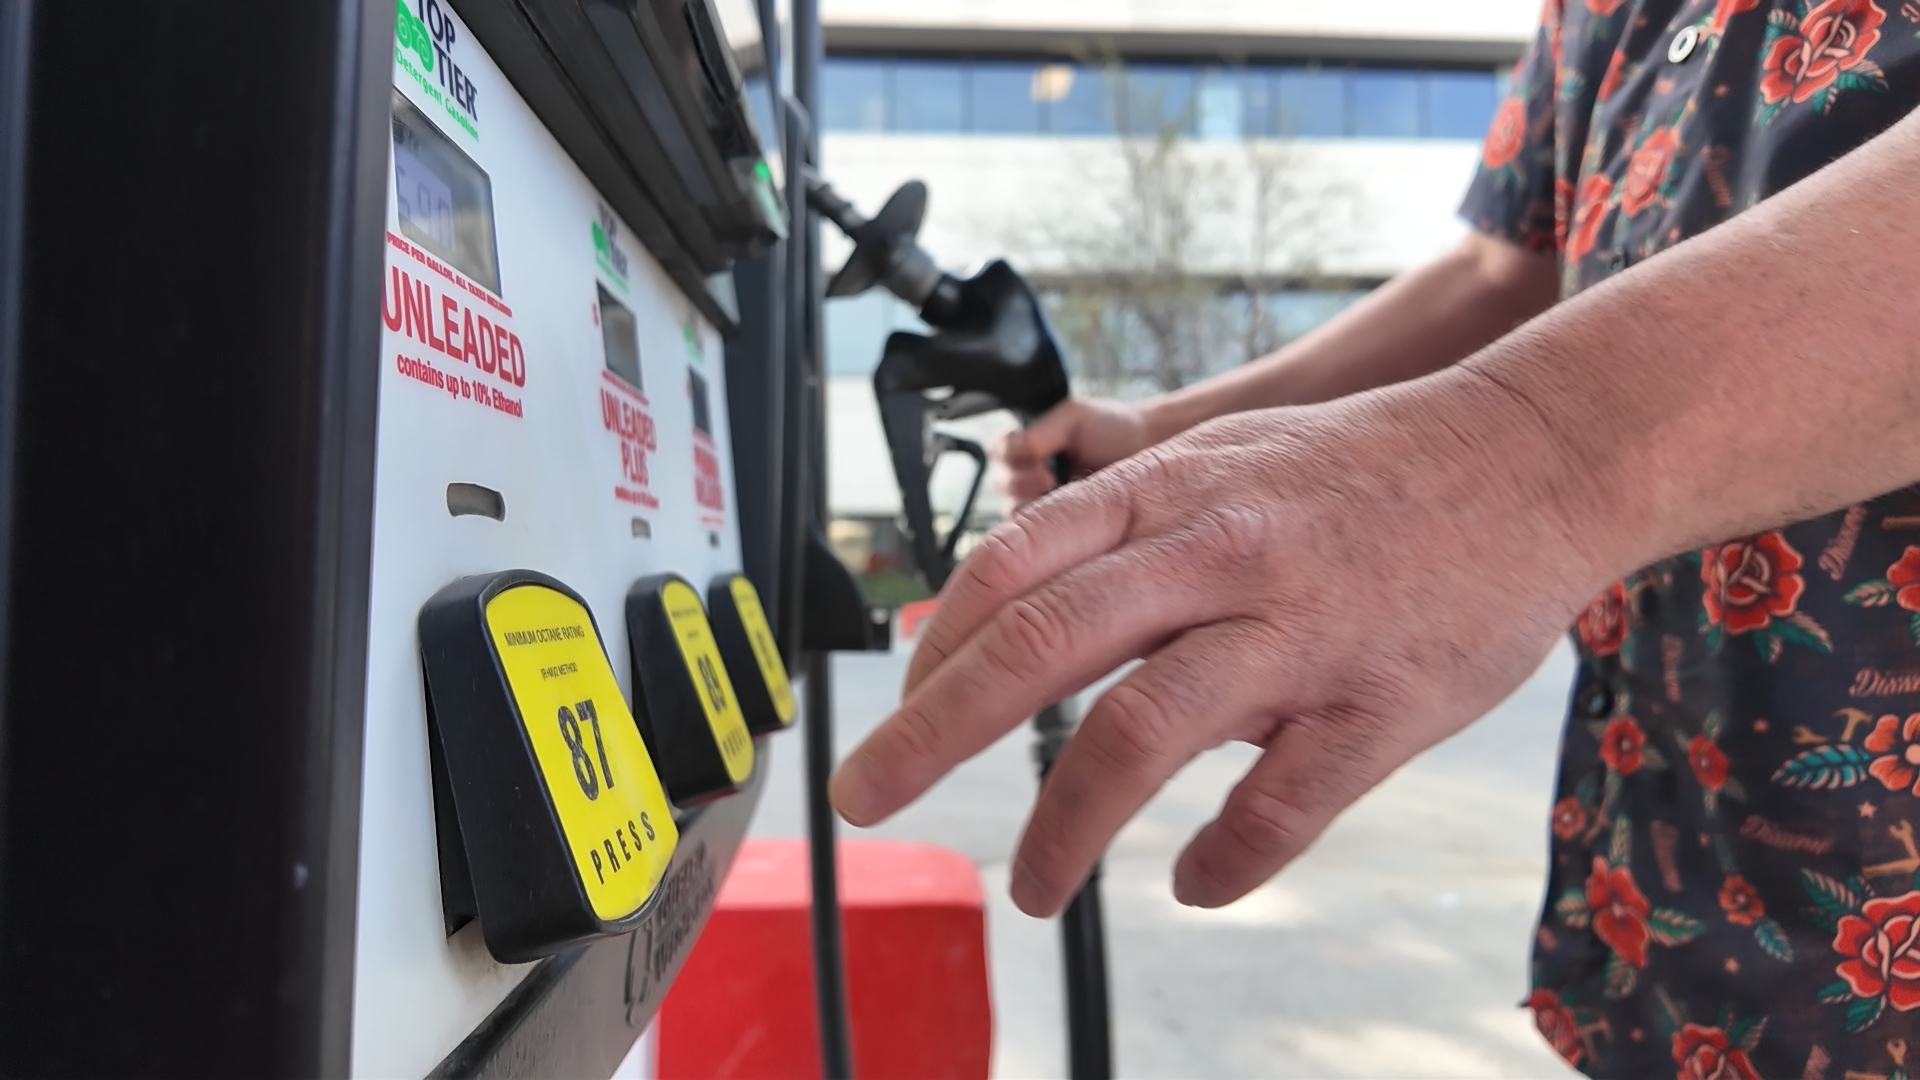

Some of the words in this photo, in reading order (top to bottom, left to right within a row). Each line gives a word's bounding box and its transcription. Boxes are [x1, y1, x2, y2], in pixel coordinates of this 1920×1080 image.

[395, 47, 442, 105] Detergent
[433, 40, 478, 121] TIER
[386, 231, 410, 255] PRICE
[411, 246, 425, 264] PER
[456, 275, 467, 290] ALL
[381, 265, 526, 388] UNLEADED
[397, 353, 444, 389] contains
[446, 373, 459, 399] up
[460, 376, 471, 399] to
[472, 381, 491, 407] 10%
[492, 388, 523, 418] Ethanol
[504, 630, 537, 646] MINIMUM
[536, 627, 563, 643] OCTANE
[561, 625, 585, 640] RATING
[558, 699, 614, 801] 87
[590, 810, 655, 885] PRESS
